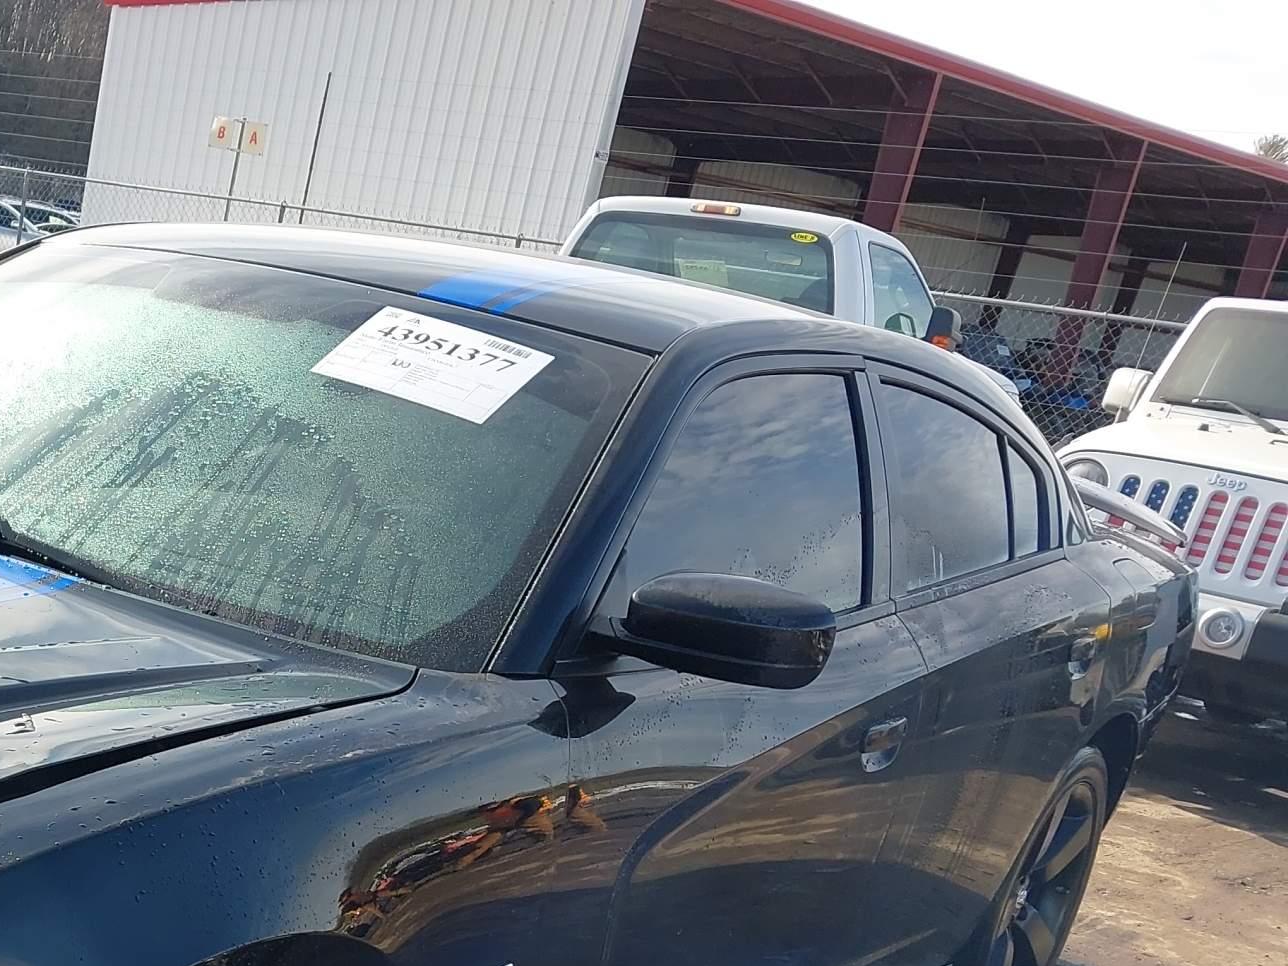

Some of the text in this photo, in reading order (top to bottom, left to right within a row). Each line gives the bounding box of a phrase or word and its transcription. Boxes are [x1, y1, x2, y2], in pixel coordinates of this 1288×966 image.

[217, 126, 226, 139] B
[249, 131, 257, 145] A
[377, 325, 518, 372] 43951377
[1208, 472, 1247, 492] Jeep
